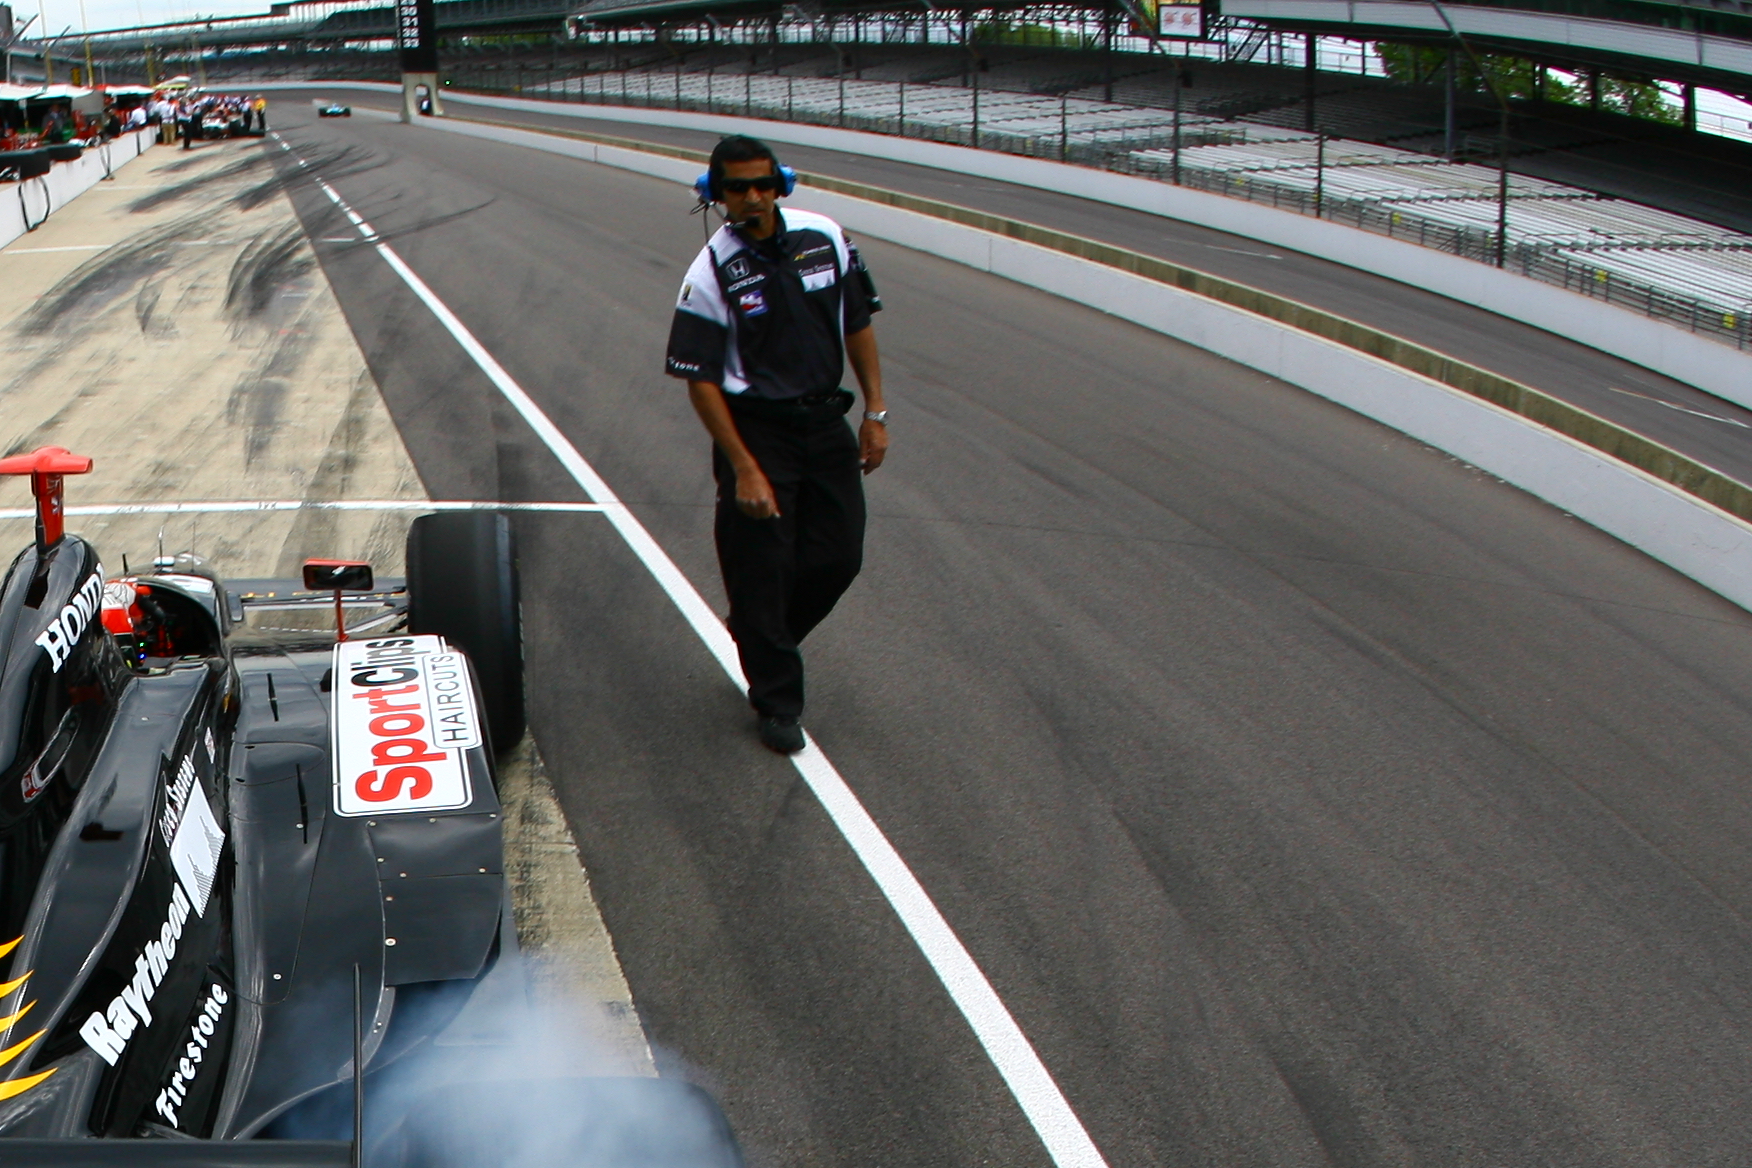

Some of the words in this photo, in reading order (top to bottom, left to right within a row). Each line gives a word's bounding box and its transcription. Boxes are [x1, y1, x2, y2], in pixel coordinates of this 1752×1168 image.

[351, 639, 447, 802] SportClips
[430, 655, 468, 742] HAIRCUTS
[79, 882, 191, 1067] Raytheon
[155, 982, 229, 1129] Firestone
